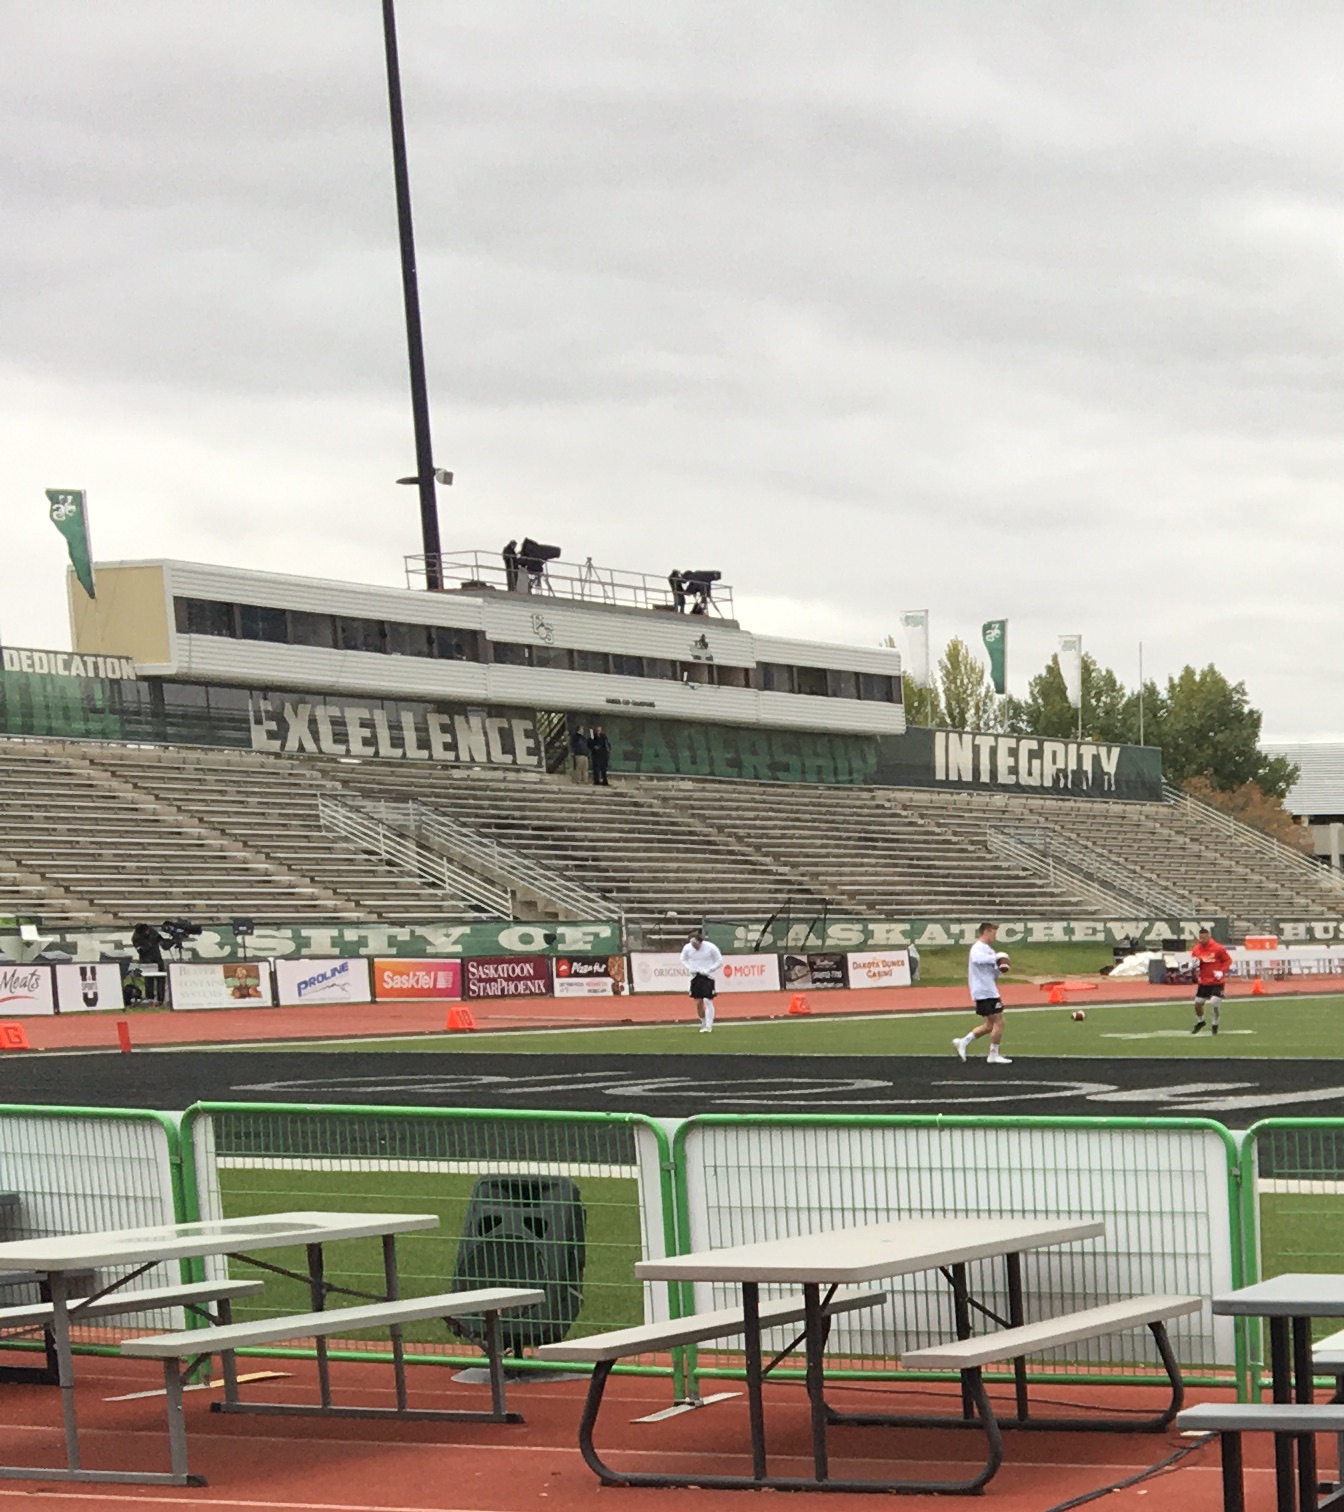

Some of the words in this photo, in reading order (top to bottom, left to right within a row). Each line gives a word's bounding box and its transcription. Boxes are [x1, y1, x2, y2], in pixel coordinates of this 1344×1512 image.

[3, 650, 137, 681] DEDICATION
[250, 697, 542, 767] EXCELLENCE
[934, 730, 1121, 791] INTEGRITY
[498, 925, 611, 951] OF
[733, 920, 1216, 949] SASKATCHEWAN
[0, 967, 41, 994] Meats
[297, 961, 350, 997] PROLINE
[382, 970, 435, 990] SaskTel
[468, 961, 535, 980] SASKATOON
[734, 964, 767, 977] MOTIF
[4, 1026, 23, 1045] G
